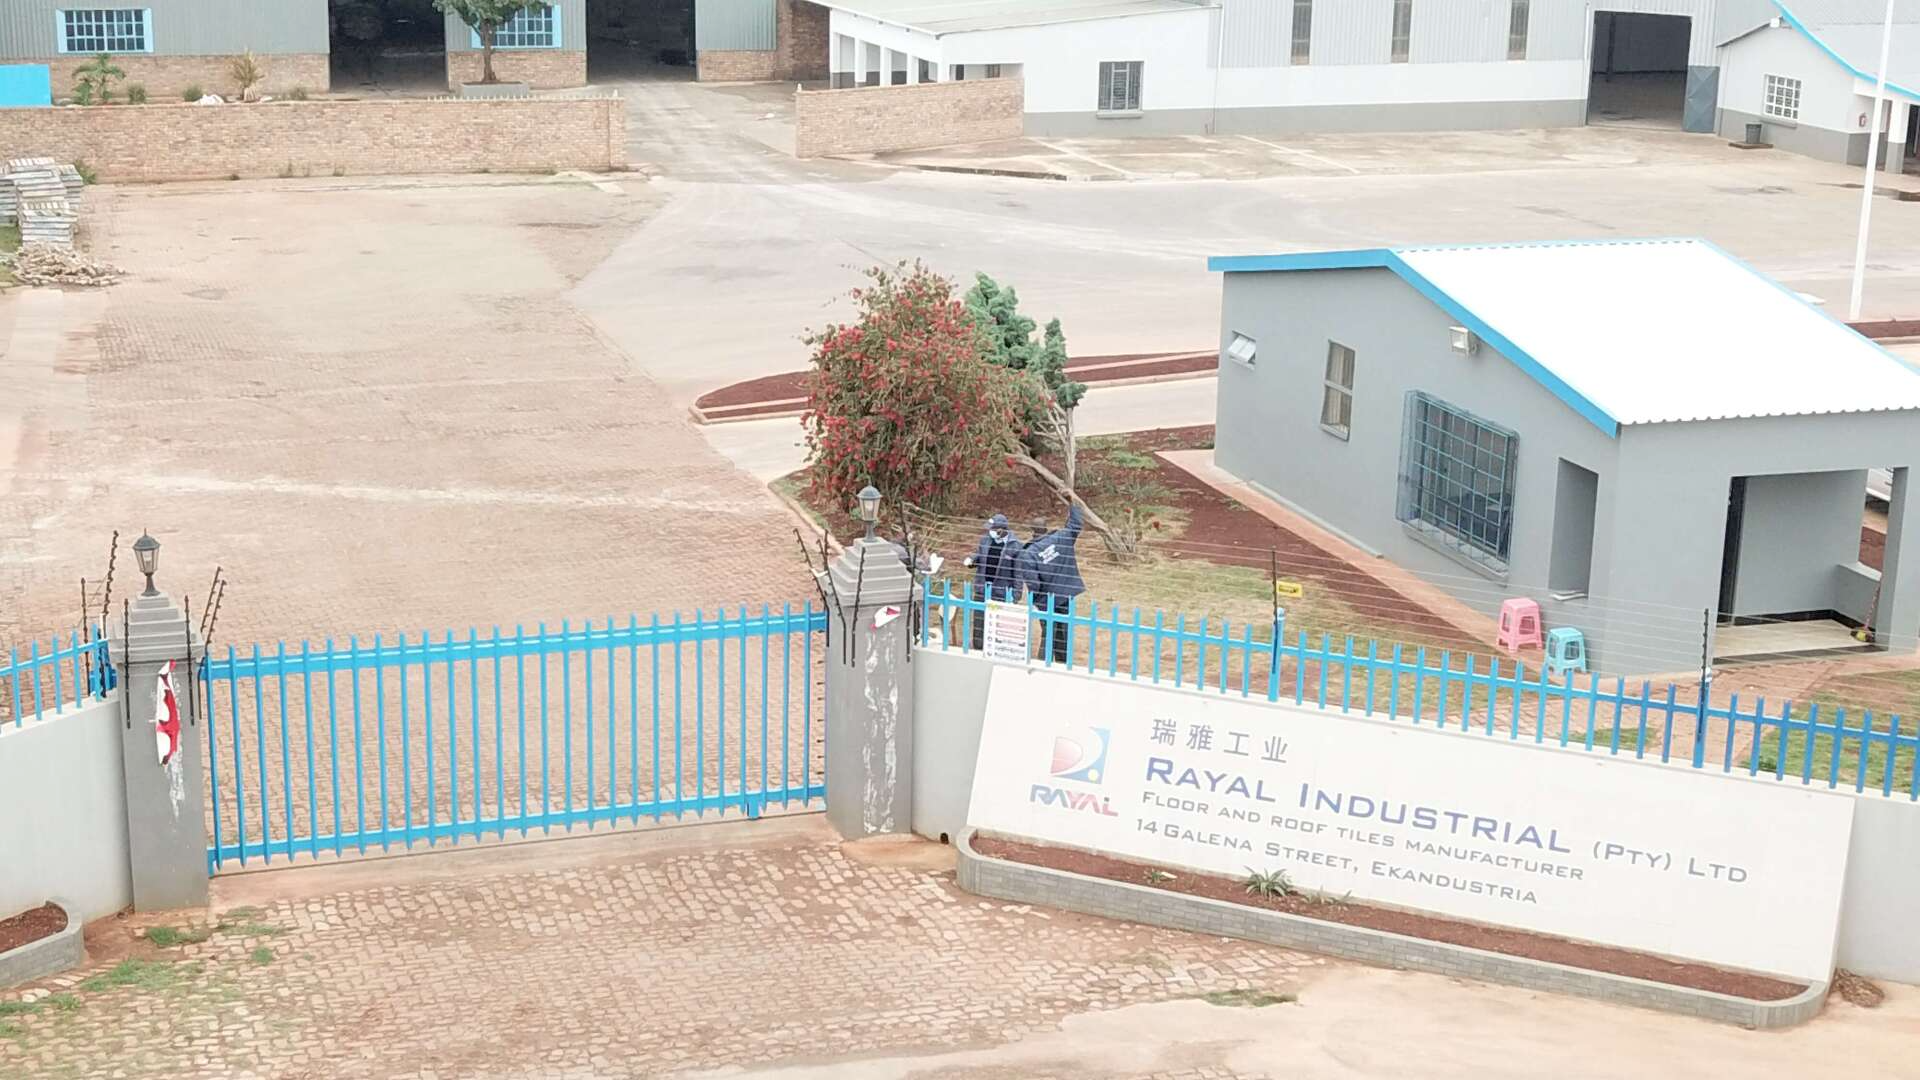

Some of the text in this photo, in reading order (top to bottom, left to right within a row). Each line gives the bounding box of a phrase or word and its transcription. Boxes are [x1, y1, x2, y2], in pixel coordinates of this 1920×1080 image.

[1149, 717, 1289, 764] 瑞雅工业
[1136, 818, 1537, 904] 14 GALENA STREET, EKANDUSTRIA
[1142, 791, 1584, 881] FLOOR AND ROOF TILES MANUFACTURER
[1145, 756, 1748, 883] RAYAL INDUSTRIAL (PTY) LTD
